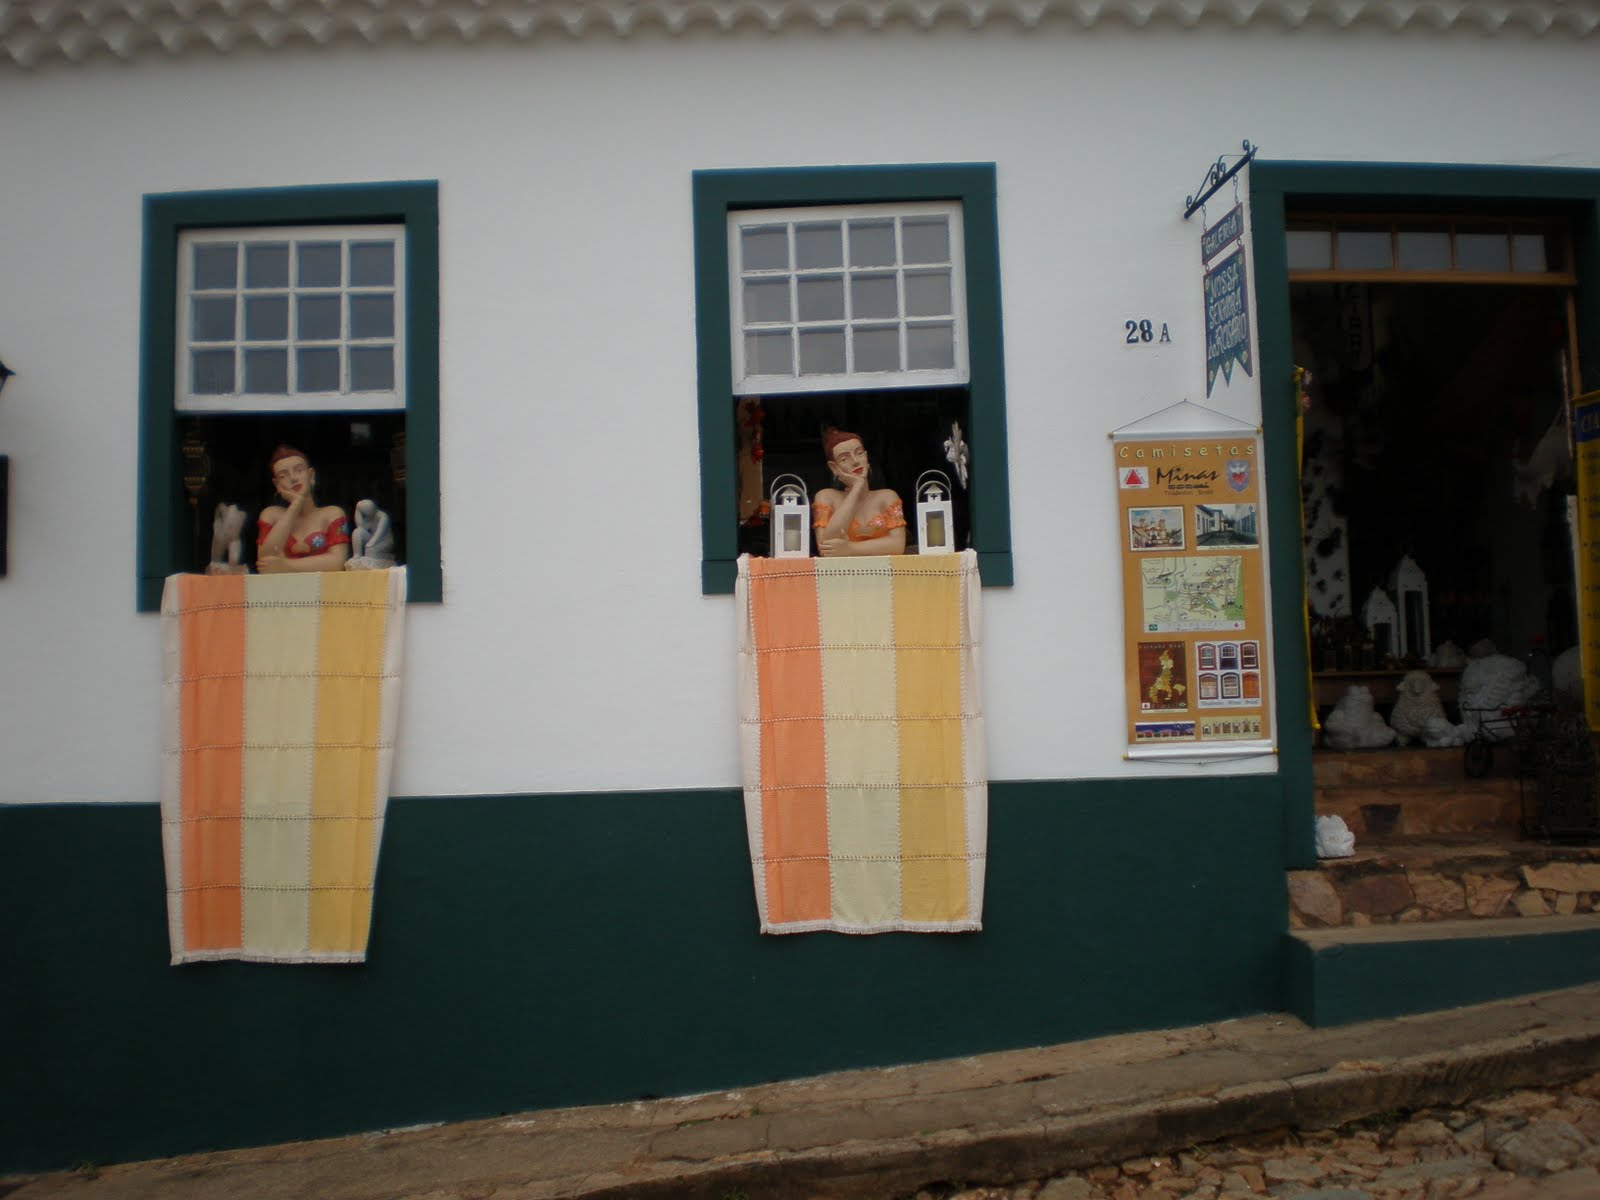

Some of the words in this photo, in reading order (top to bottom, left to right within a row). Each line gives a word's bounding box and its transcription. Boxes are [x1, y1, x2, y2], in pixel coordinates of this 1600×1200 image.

[1210, 263, 1239, 303] NOSSA
[1125, 319, 1154, 343] 28
[1159, 323, 1171, 342] A
[1119, 445, 1254, 458] Camisetas
[1156, 466, 1219, 485] Minas
